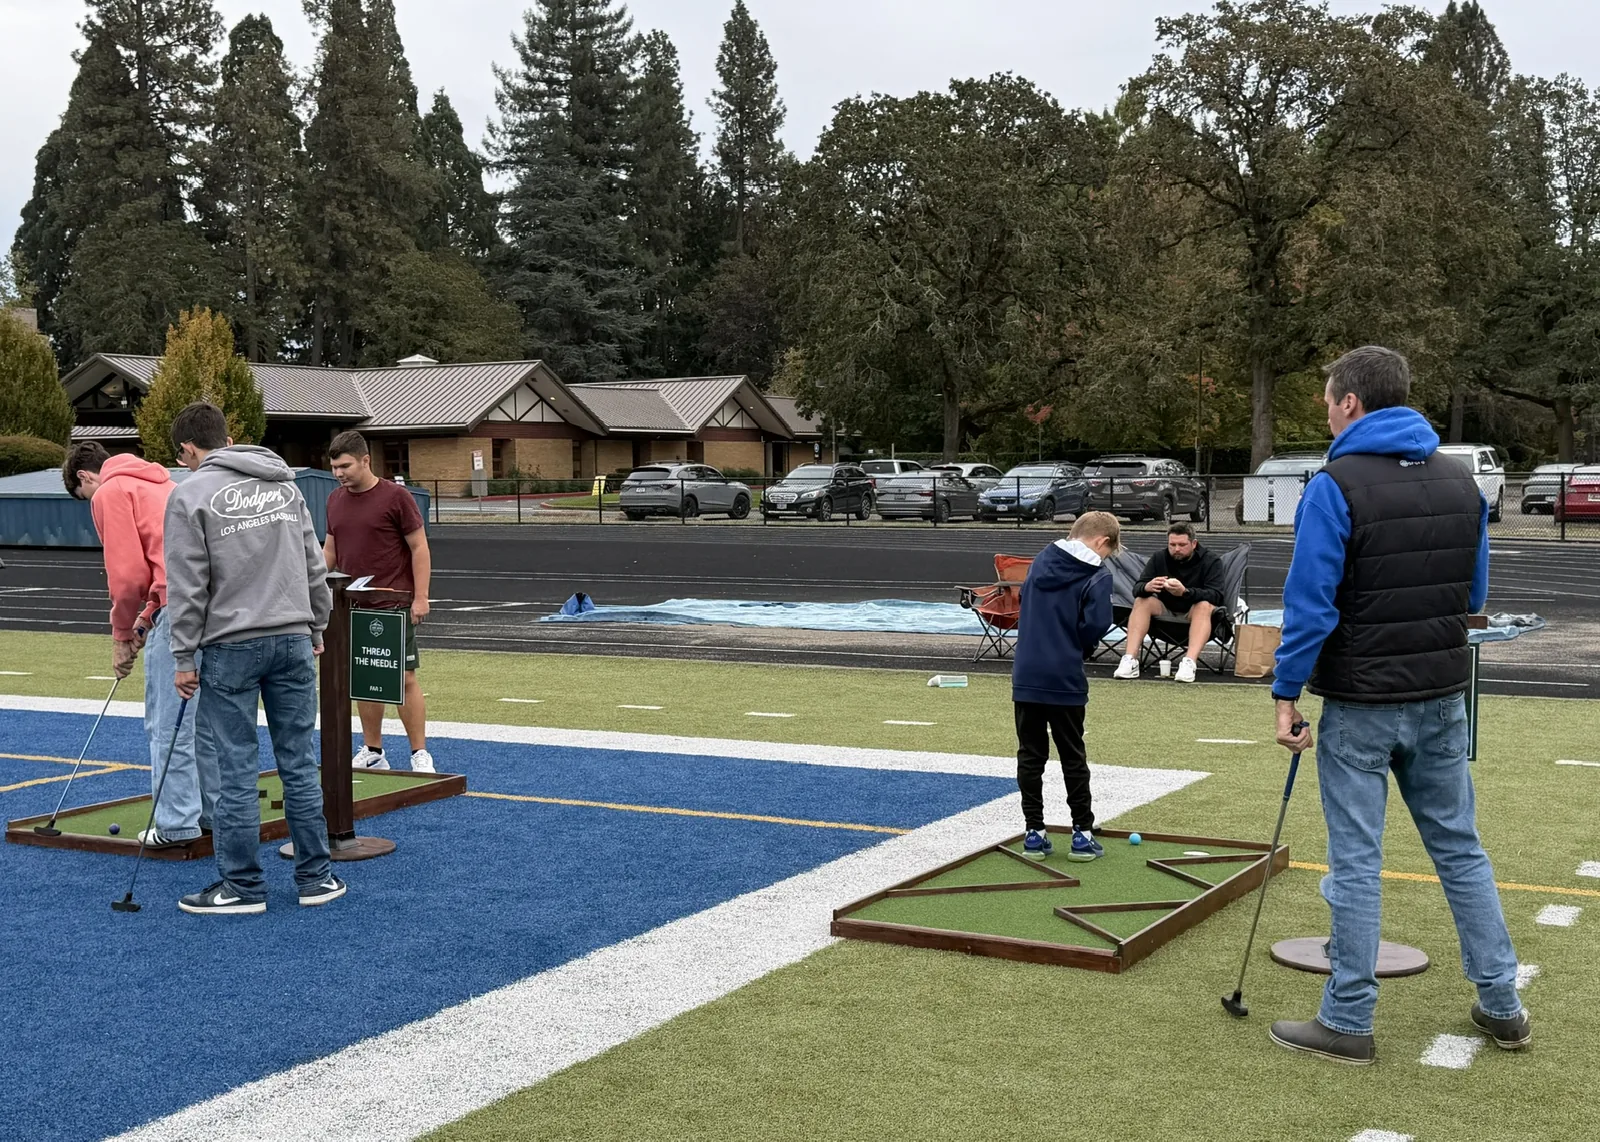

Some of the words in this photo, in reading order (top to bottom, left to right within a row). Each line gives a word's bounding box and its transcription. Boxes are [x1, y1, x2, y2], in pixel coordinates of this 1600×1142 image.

[224, 484, 286, 513] Dodgers
[220, 525, 236, 536] LOS
[237, 515, 270, 531] ANGELES
[270, 511, 299, 522] BASBALL
[361, 646, 392, 657] THREAD
[354, 656, 370, 666] THE
[370, 658, 399, 669] NEEDLE
